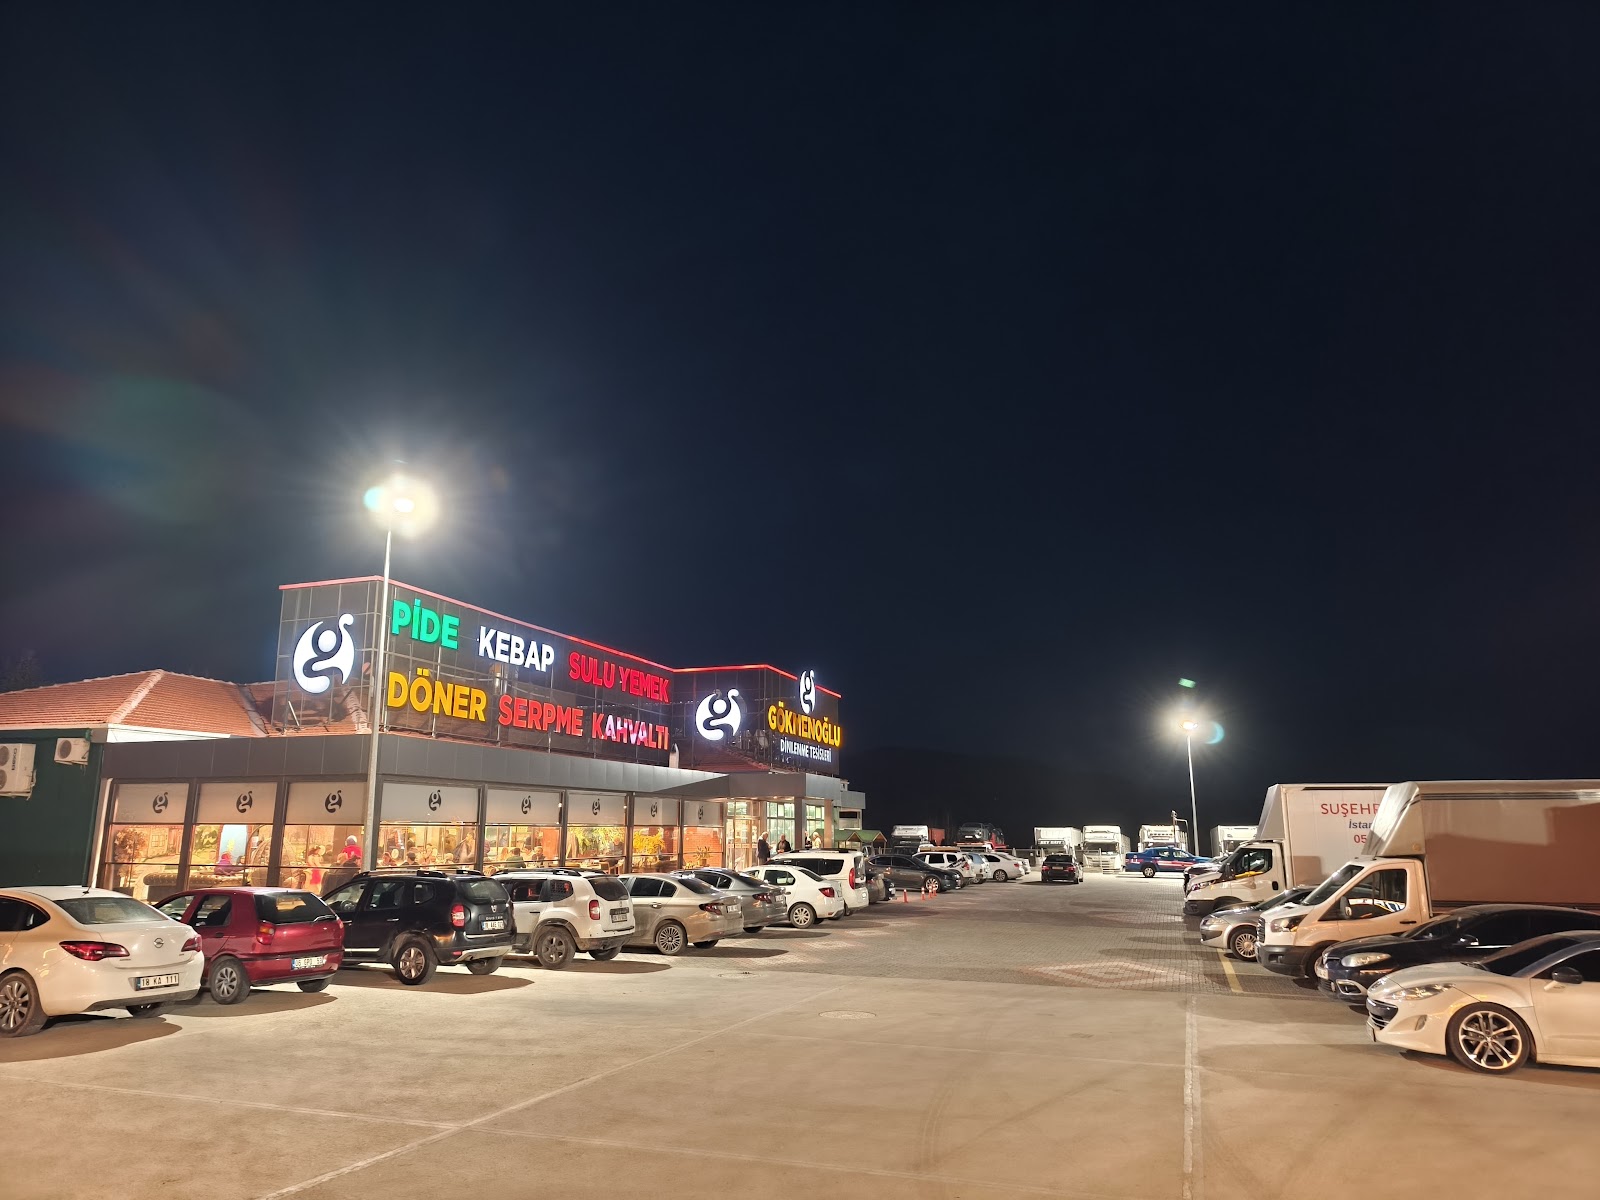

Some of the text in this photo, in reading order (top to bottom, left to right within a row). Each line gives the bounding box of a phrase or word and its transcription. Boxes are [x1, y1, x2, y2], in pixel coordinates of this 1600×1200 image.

[391, 598, 670, 703] PİDE KEBAP SULU YEMEK
[387, 667, 670, 750] DÖNER SERPME KAHVALTI
[768, 701, 841, 747] GÖKMENOĞLU
[142, 978, 150, 987] 18
[166, 975, 177, 985] 111
